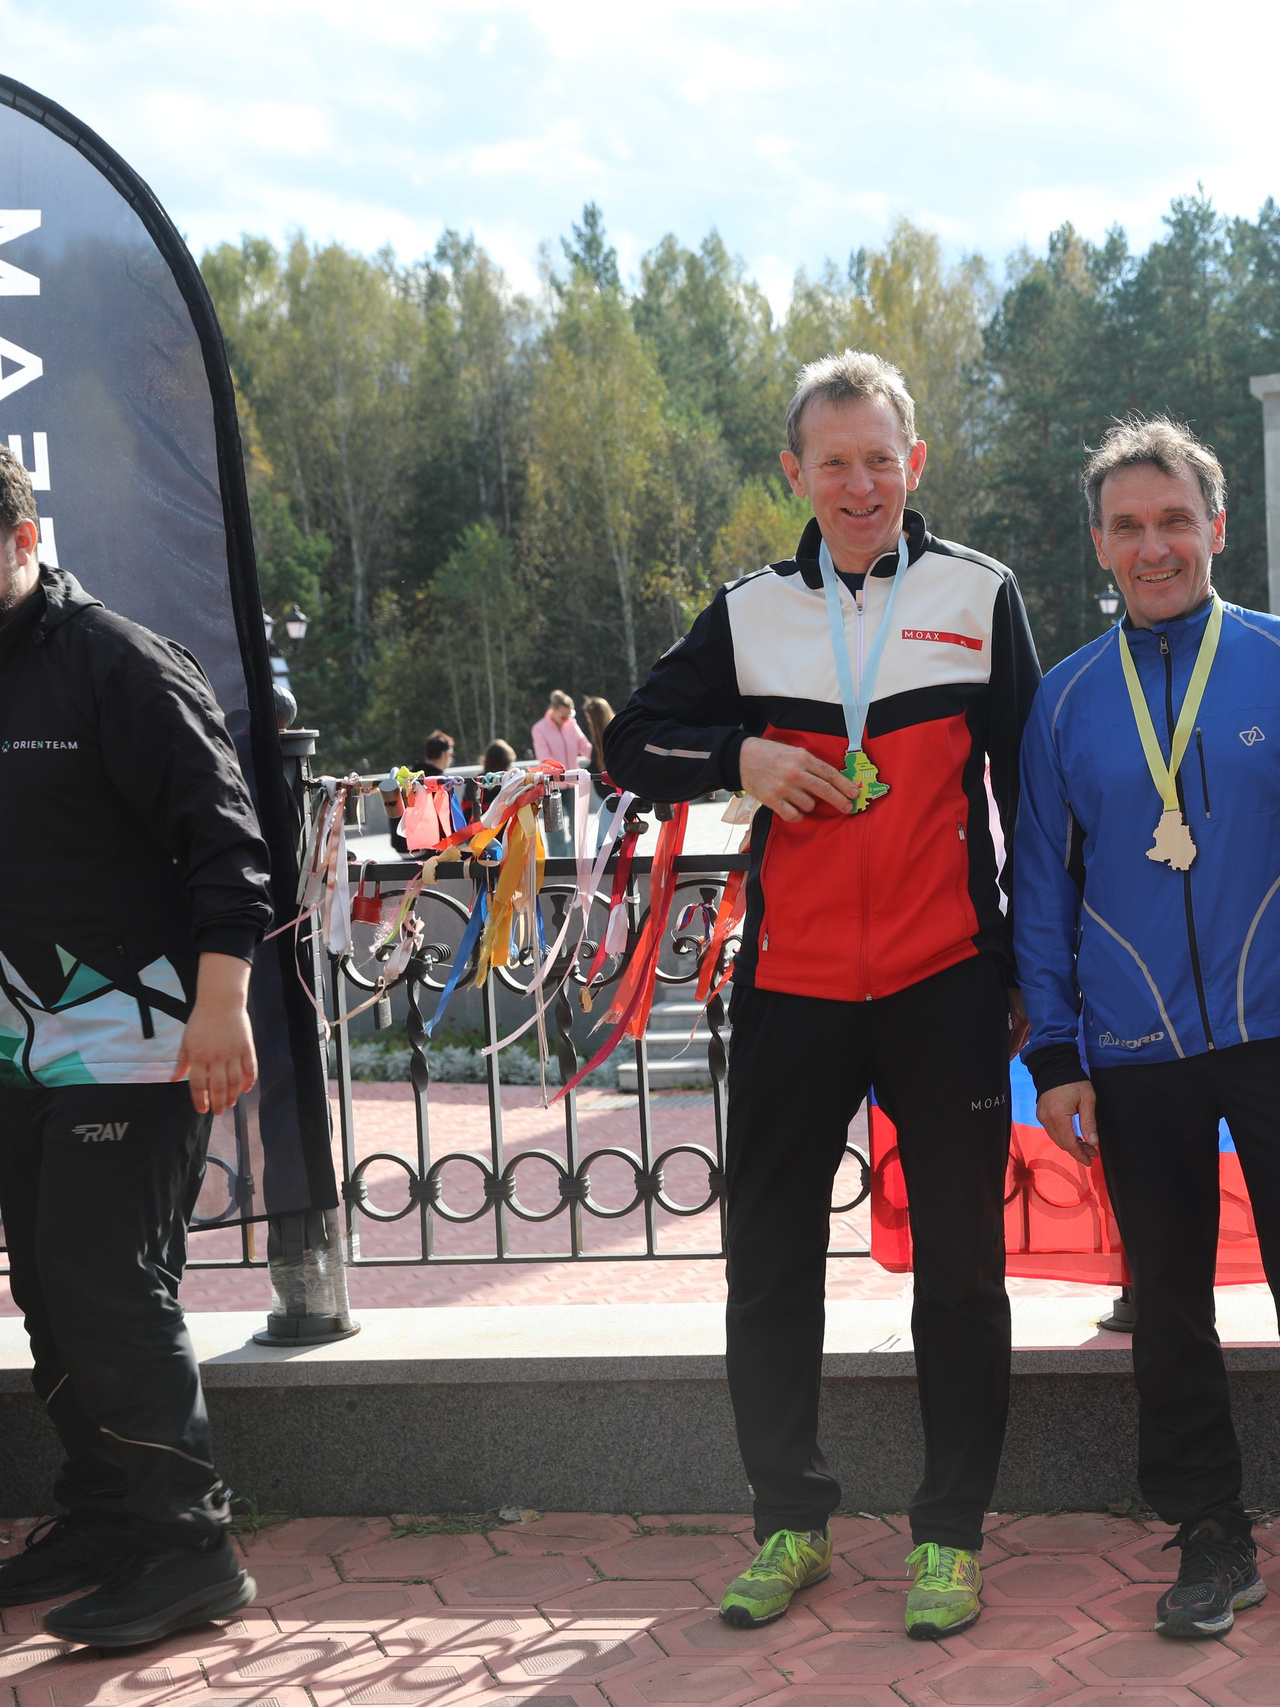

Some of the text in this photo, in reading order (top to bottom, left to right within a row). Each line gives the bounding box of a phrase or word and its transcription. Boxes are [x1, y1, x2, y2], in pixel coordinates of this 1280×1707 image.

[904, 630, 940, 641] MOAX
[12, 740, 79, 750] ORIENTEAM
[862, 771, 874, 779] 101
[1114, 1031, 1165, 1049] NORD
[971, 1093, 1006, 1111] MOAX
[71, 1121, 130, 1143] RAY
